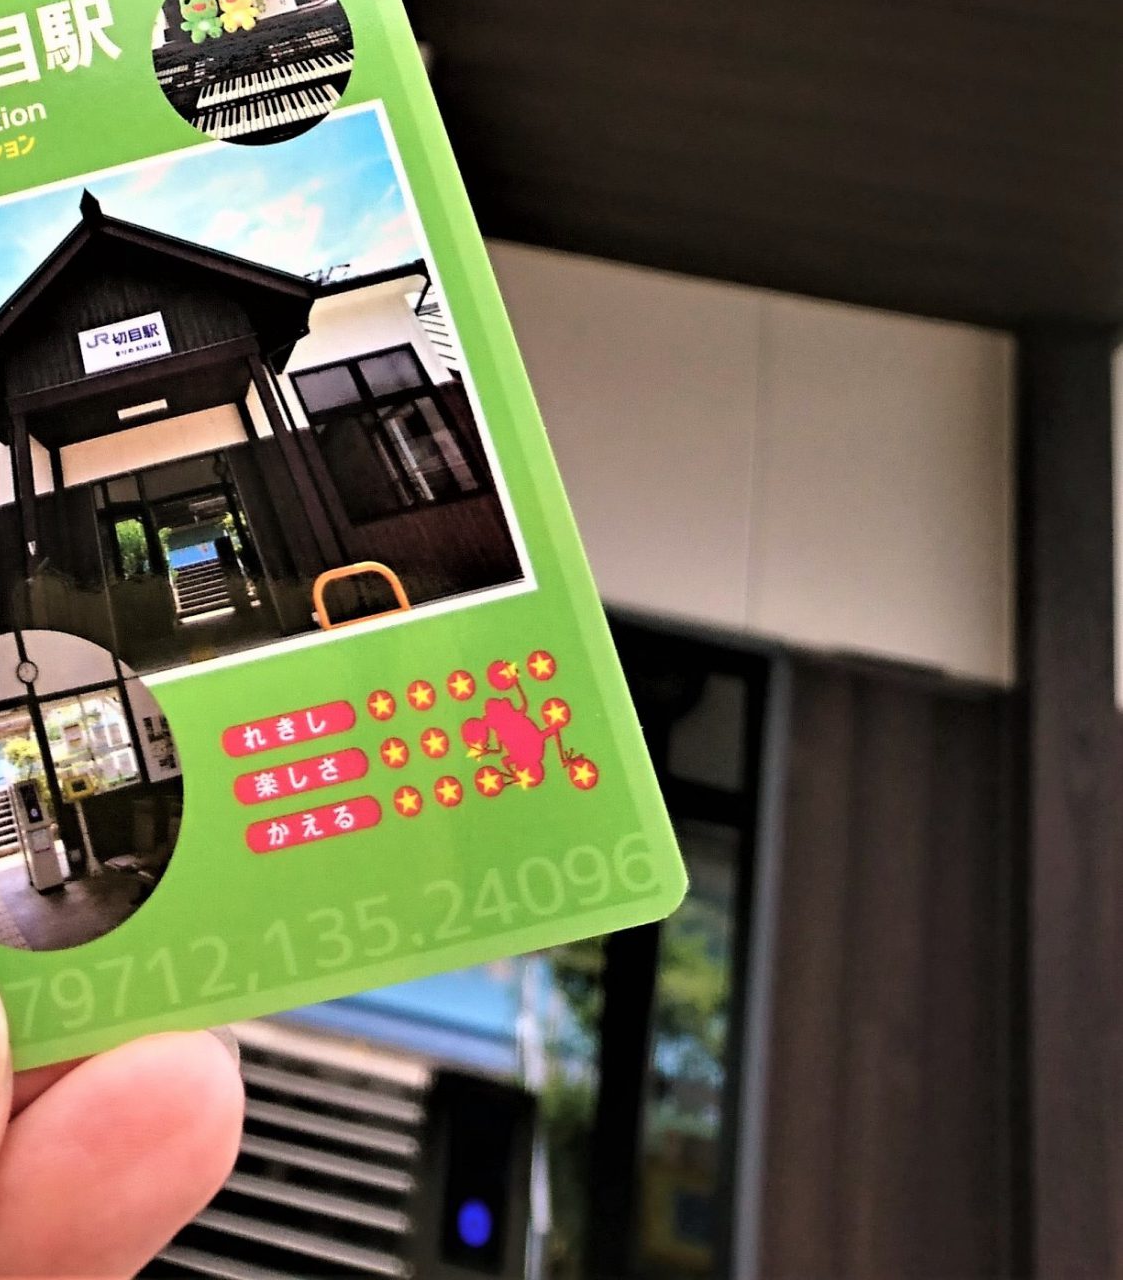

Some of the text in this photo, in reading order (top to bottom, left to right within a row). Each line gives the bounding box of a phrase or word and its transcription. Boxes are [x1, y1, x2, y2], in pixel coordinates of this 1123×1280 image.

[243, 711, 327, 749] れきし
[254, 757, 339, 797] 楽しさ
[267, 805, 354, 845] かえる
